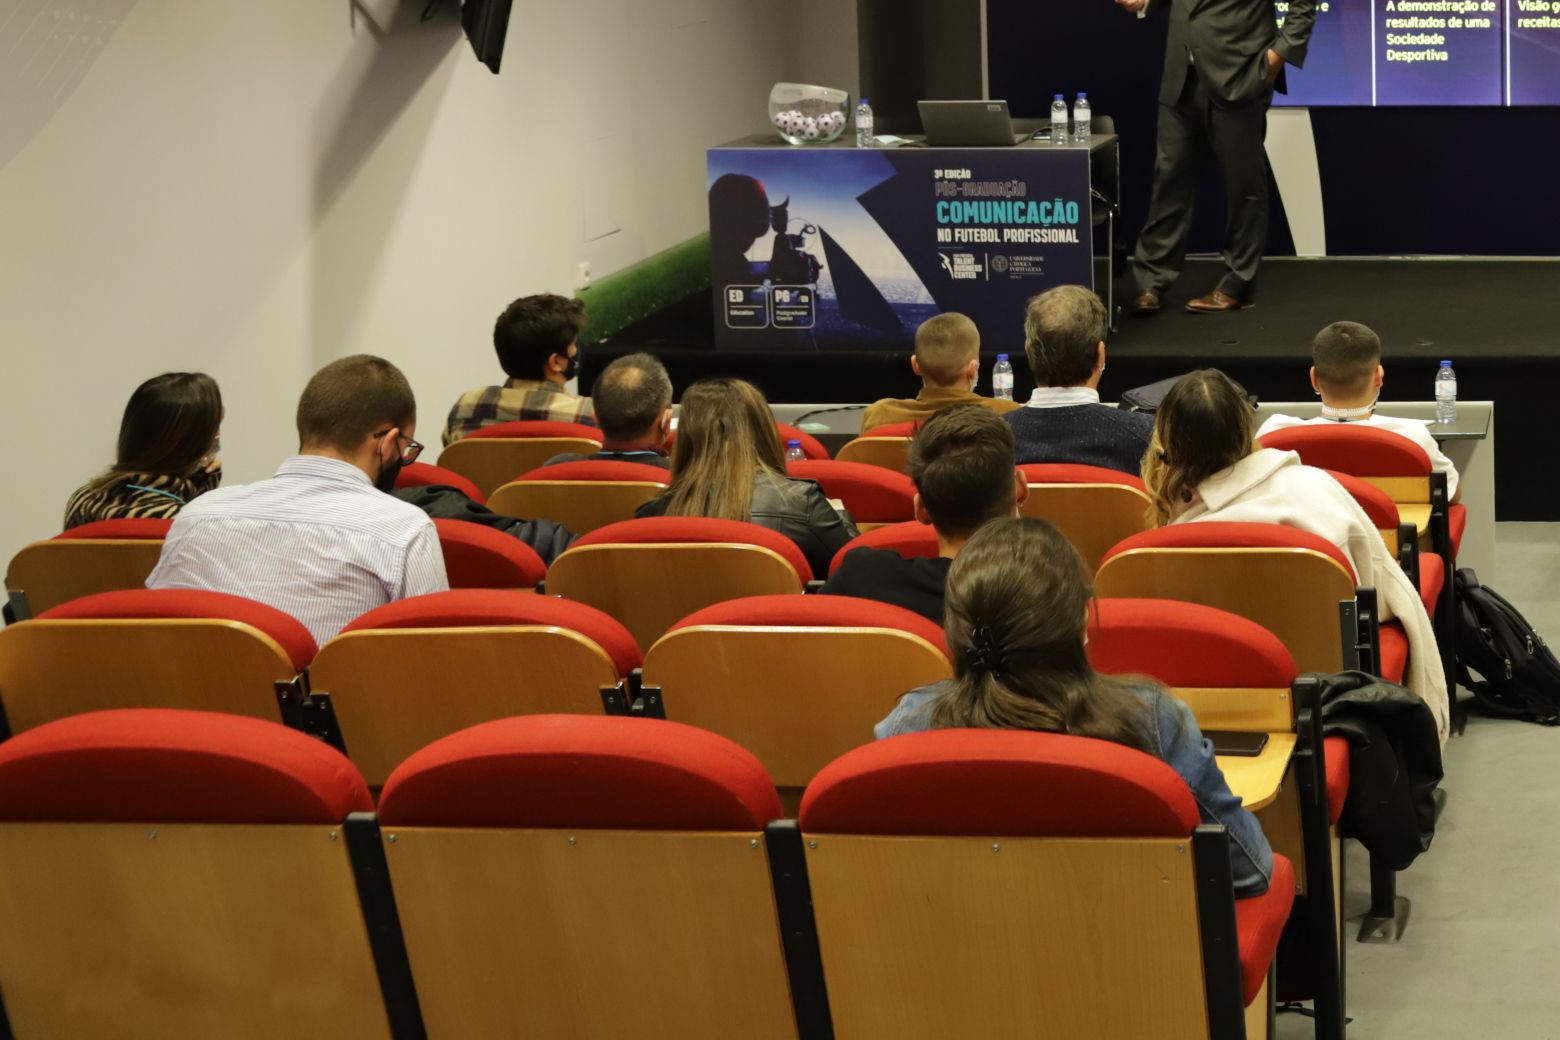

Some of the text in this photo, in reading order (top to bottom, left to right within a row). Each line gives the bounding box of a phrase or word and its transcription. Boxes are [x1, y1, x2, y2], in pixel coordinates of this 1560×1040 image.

[1386, 0, 1496, 14] A demonstração de
[1517, 0, 1550, 11] Visão
[1386, 16, 1490, 28] resultados de uma
[1386, 32, 1445, 45] Sociedade
[1386, 49, 1449, 63] Desportiva
[945, 168, 971, 179] EDIÇÃO
[936, 198, 1079, 227] COMUNICAÇÃO
[937, 228, 1079, 243] NO FUTEBOL PROFISSIONAL
[729, 290, 743, 303] ED
[775, 290, 790, 303] PG
